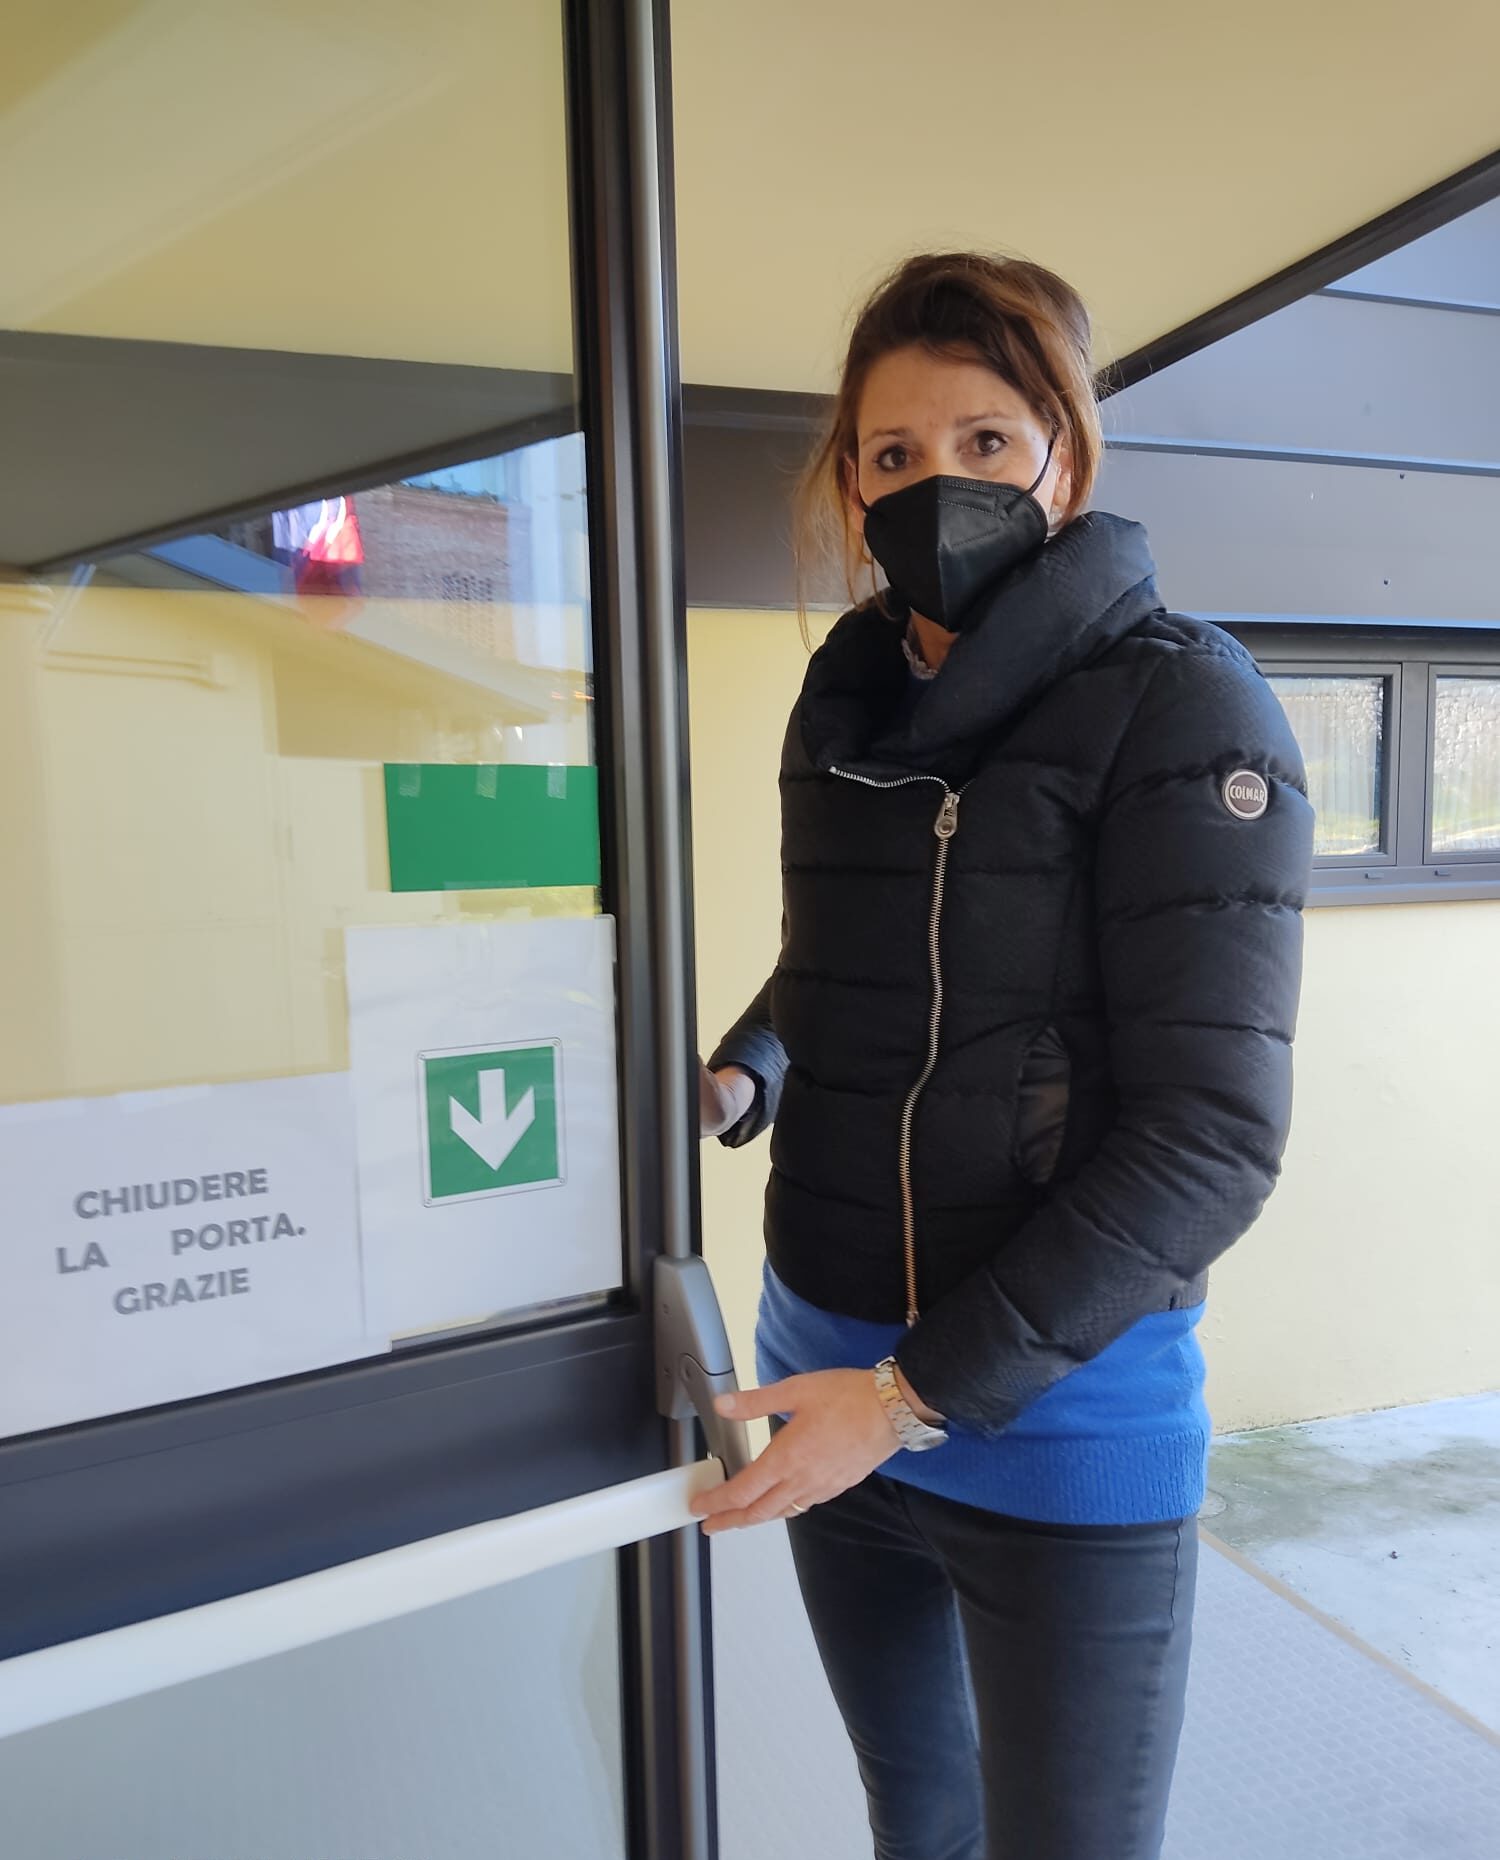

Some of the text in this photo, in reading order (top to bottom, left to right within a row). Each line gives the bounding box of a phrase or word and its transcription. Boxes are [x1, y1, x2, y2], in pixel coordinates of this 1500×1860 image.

[1229, 784, 1264, 803] COLMAR
[75, 1168, 269, 1219] CHIUDERE
[56, 1212, 306, 1274] LA PORTA.
[113, 1267, 250, 1315] GRAZIE
